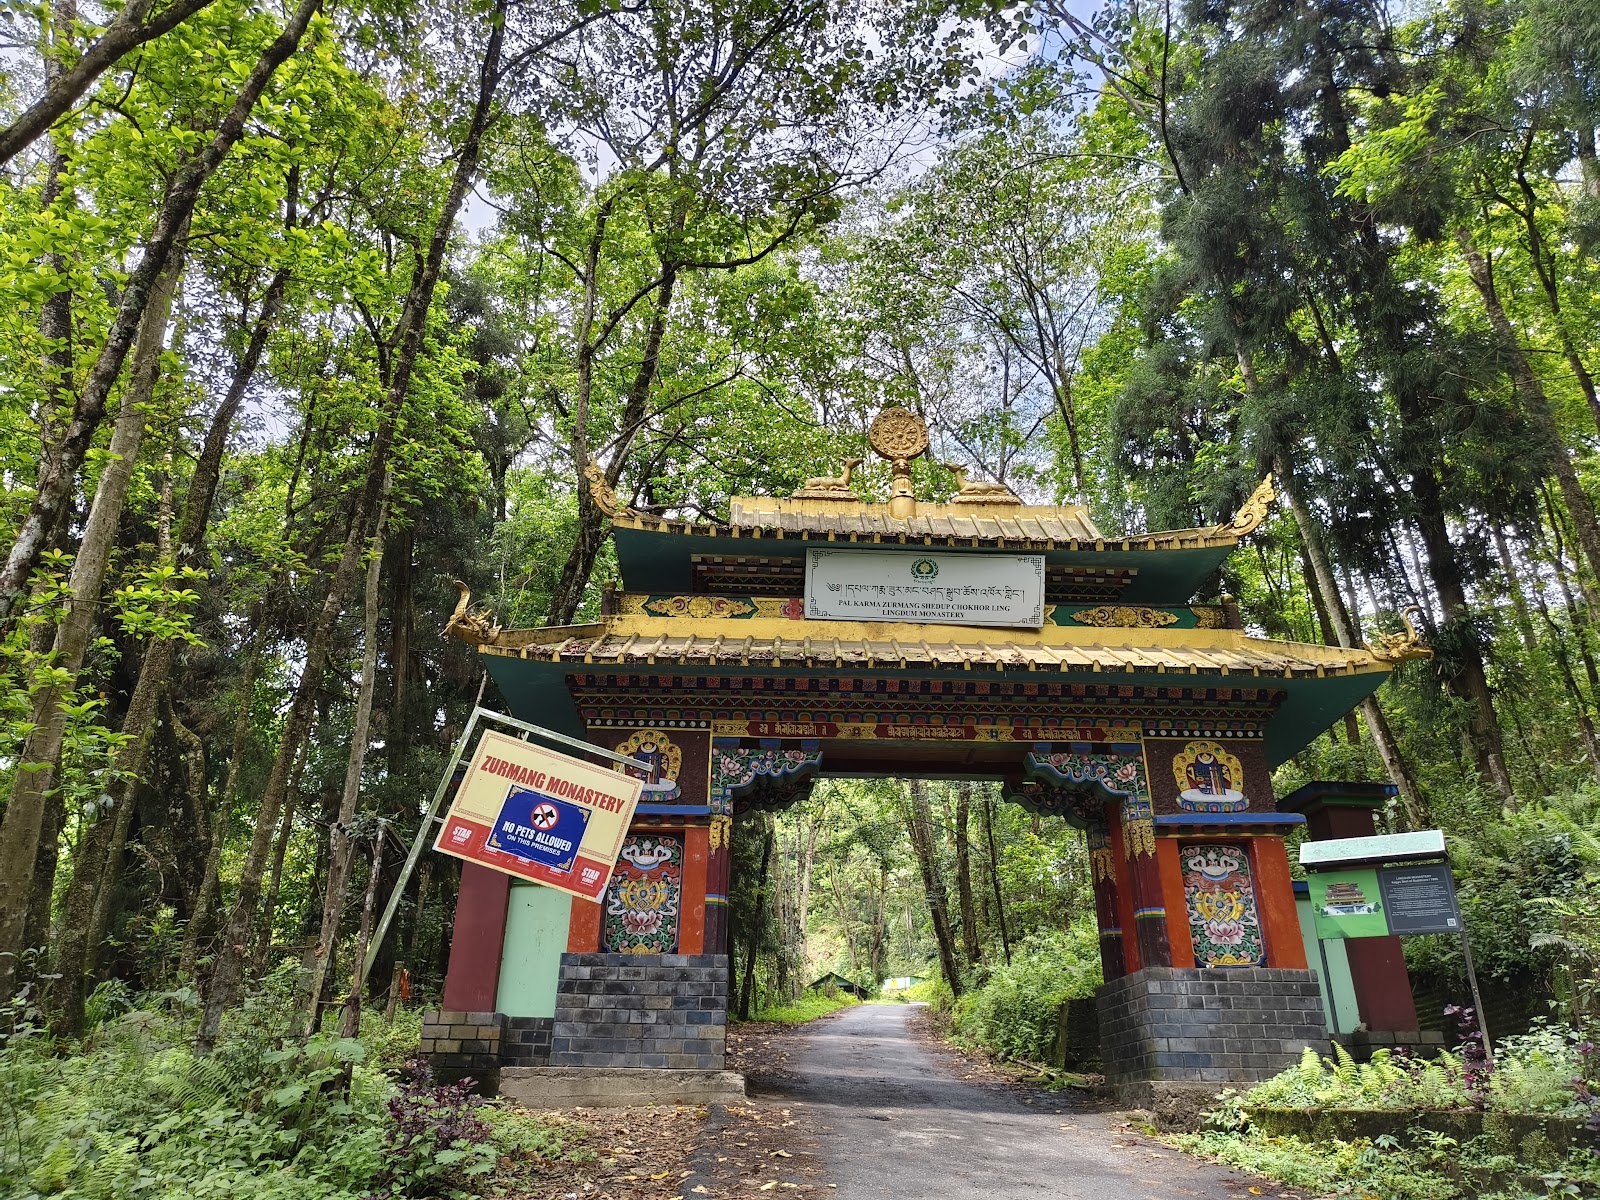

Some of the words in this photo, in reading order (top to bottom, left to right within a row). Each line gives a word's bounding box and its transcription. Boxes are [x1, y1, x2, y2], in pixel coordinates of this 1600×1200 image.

[480, 755, 546, 789] ZURMANG
[546, 777, 625, 814] MONASTERY
[452, 826, 472, 839] STAR
[502, 821, 515, 833] NO
[515, 825, 536, 840] PETS
[535, 832, 572, 852] ALLOWED
[518, 837, 530, 846] THIS
[531, 842, 561, 856] PREMISES
[581, 867, 600, 880] STAR
